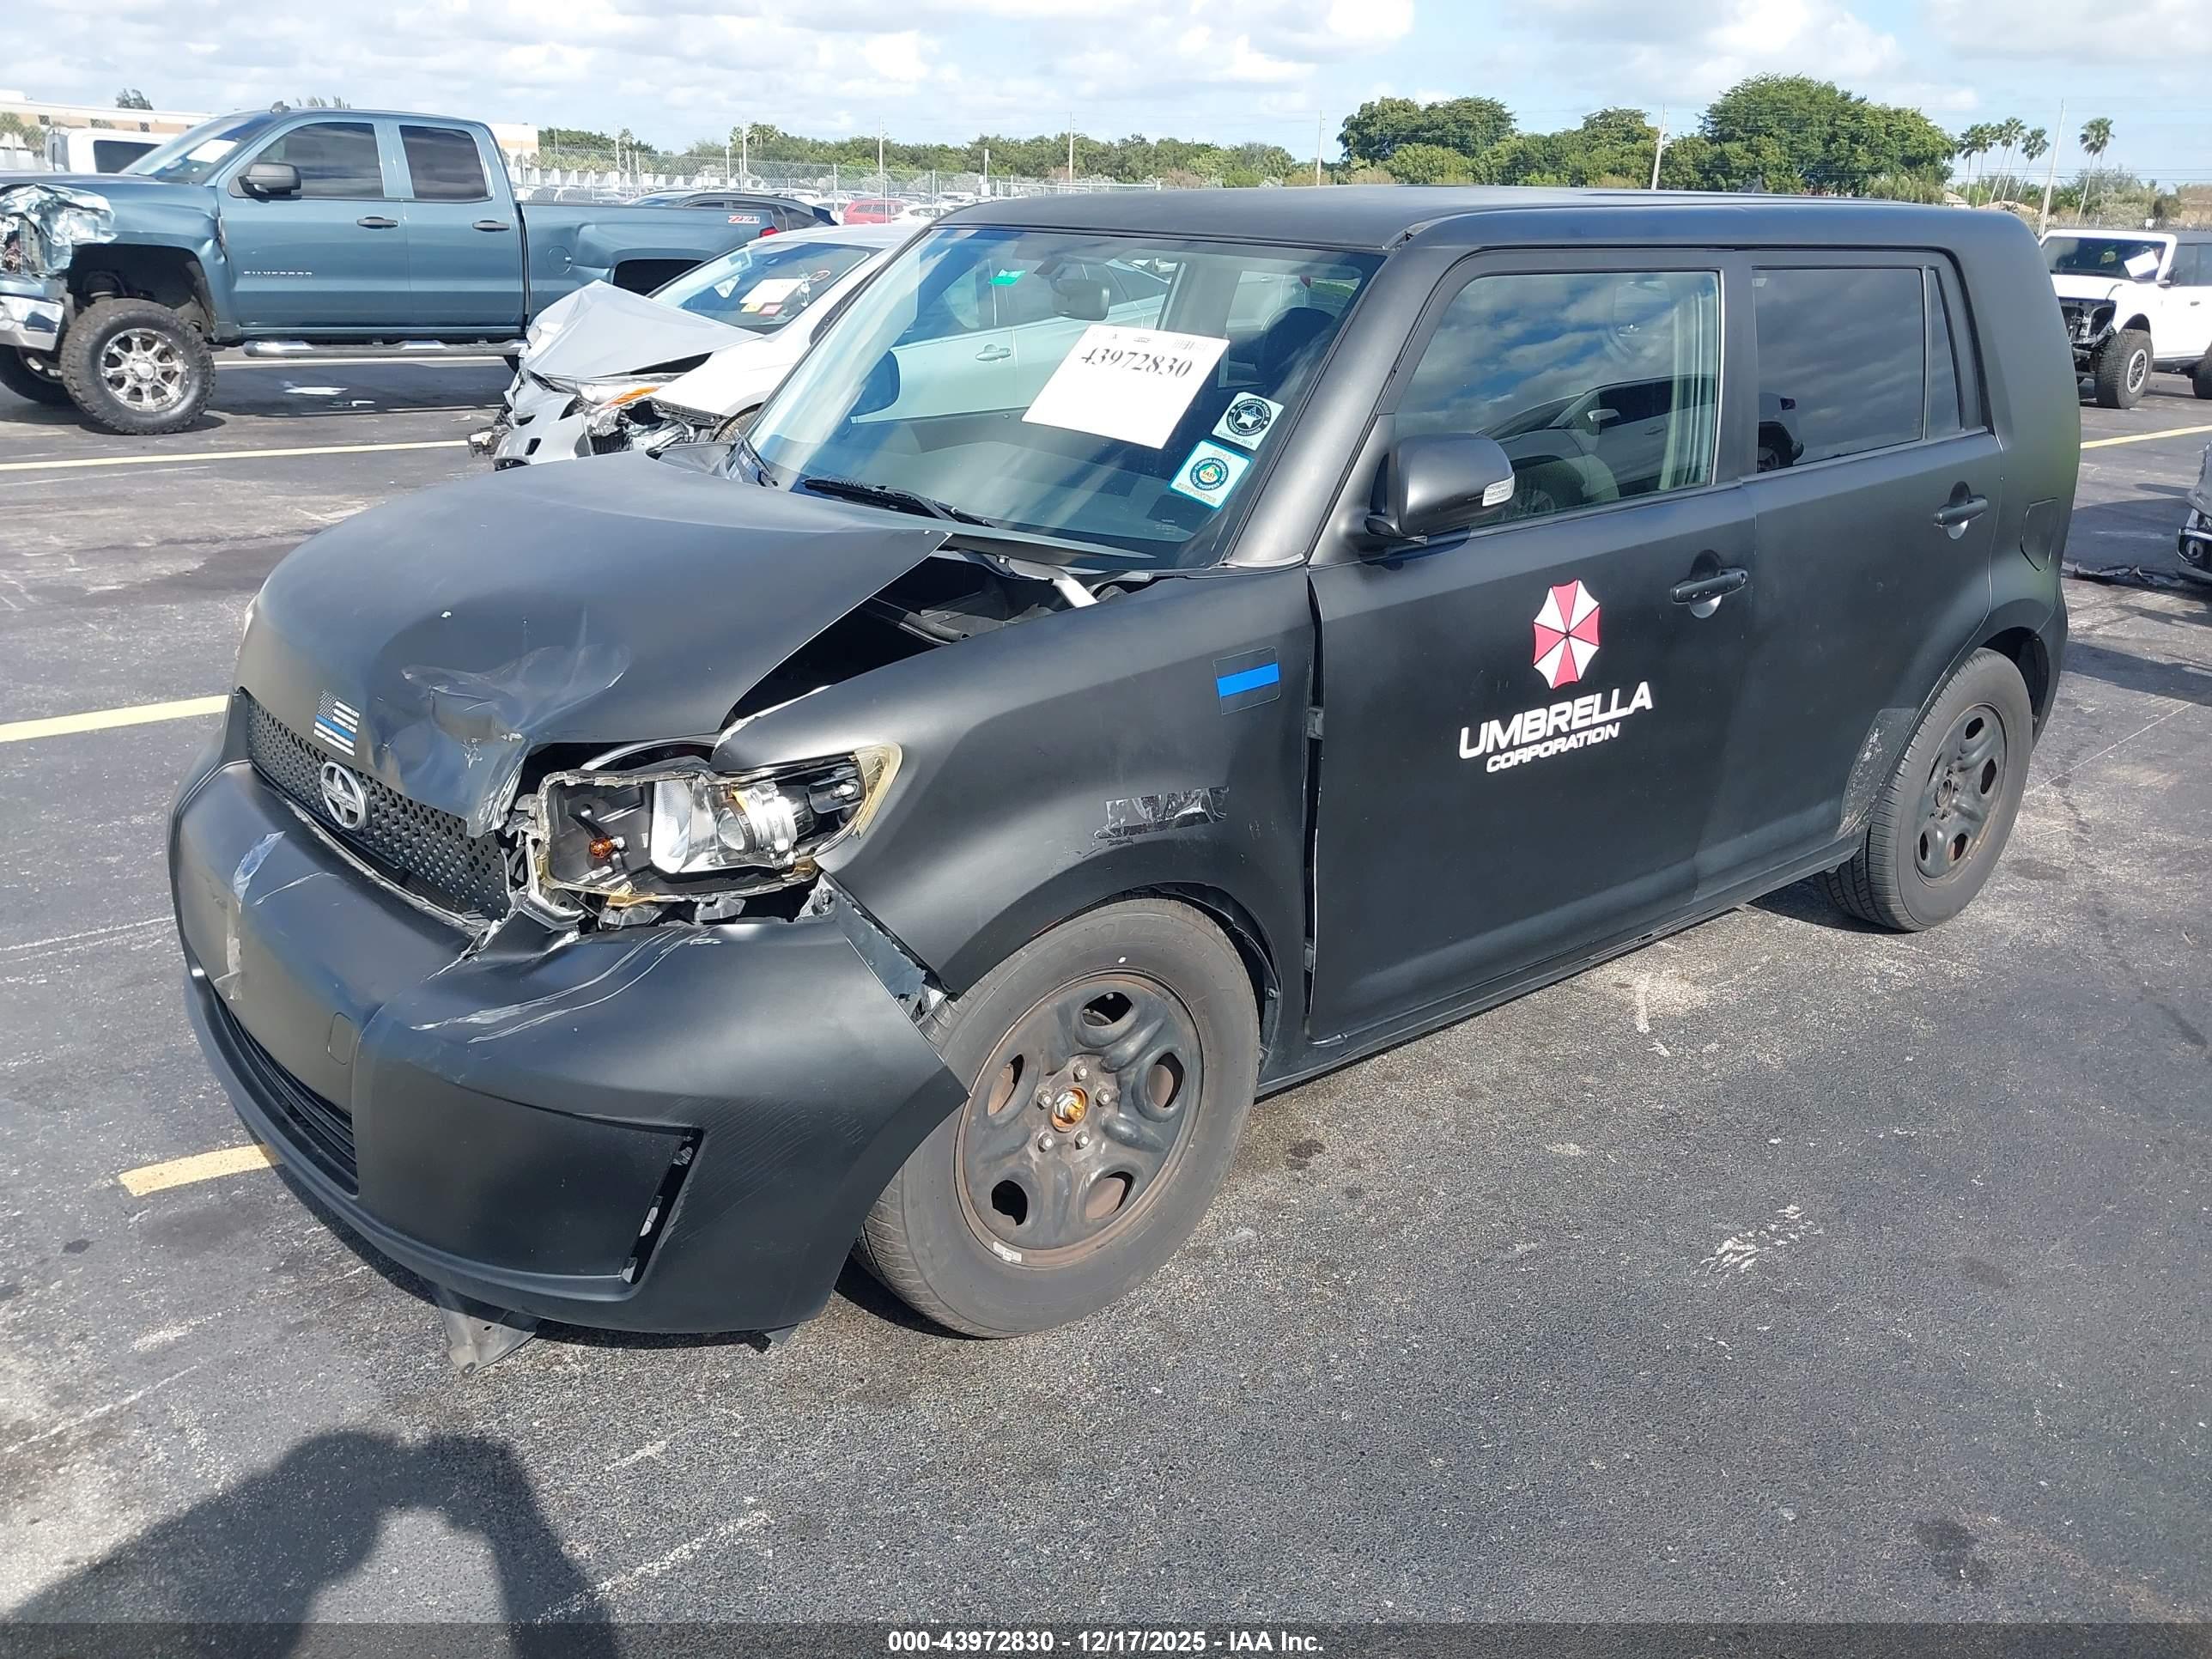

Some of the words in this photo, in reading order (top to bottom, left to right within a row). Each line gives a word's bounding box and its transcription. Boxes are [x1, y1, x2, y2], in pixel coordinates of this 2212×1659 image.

[1081, 346, 1194, 379] 43972830
[1459, 680, 1654, 760] UMBRELLA
[1486, 721, 1621, 774] CORPORATION
